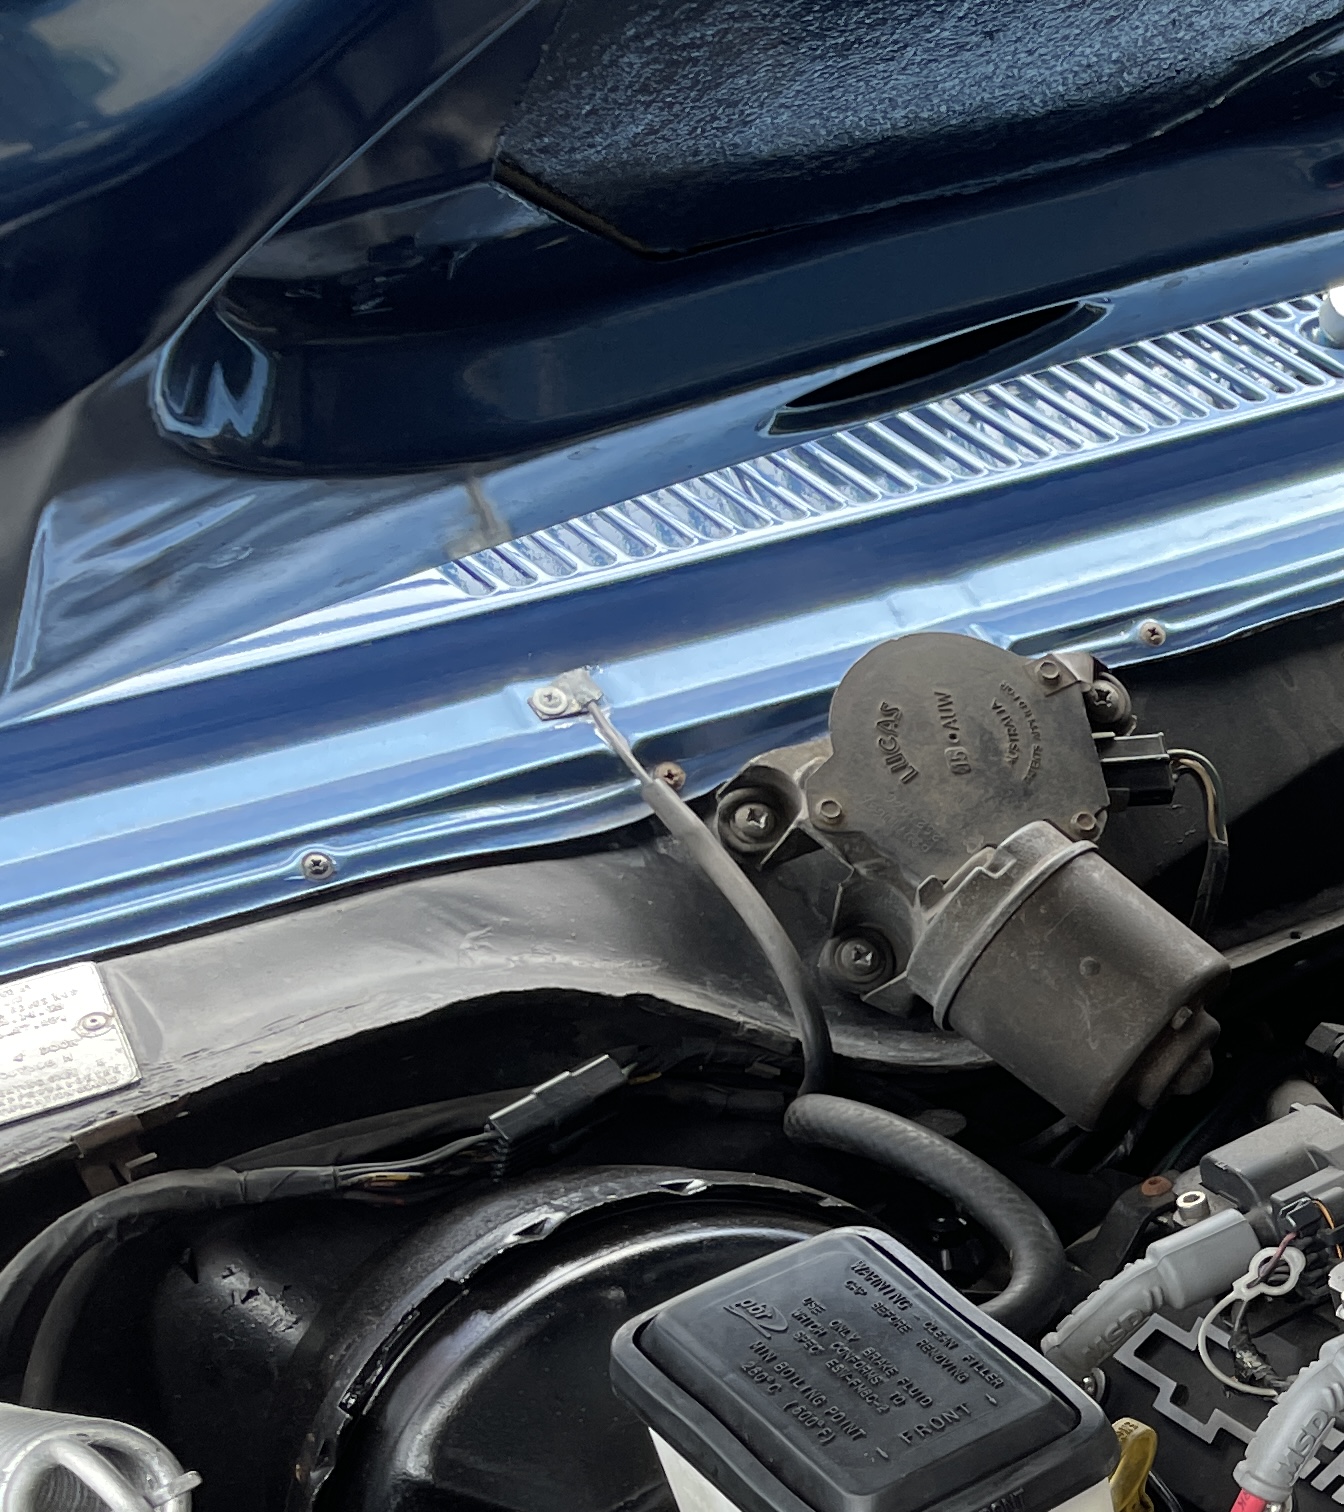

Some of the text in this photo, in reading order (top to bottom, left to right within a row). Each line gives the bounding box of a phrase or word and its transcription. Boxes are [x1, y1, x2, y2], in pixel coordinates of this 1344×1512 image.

[875, 700, 919, 785] LUCAS
[791, 1308, 906, 1407] WHICH CONFORMS TO
[793, 1331, 825, 1356] SPEC
[829, 1319, 861, 1344] ONLY
[862, 1347, 899, 1378] BRAKE
[897, 1376, 933, 1408] FLUID
[850, 1259, 913, 1312] WARNING
[961, 1353, 1004, 1390] FILLER
[871, 1301, 913, 1334] BEFORE
[915, 1338, 970, 1384] REMOVING
[749, 1340, 867, 1442] MIN BOILING POINT
[898, 1402, 973, 1445] FRONT
[1276, 1412, 1330, 1483] MSD
